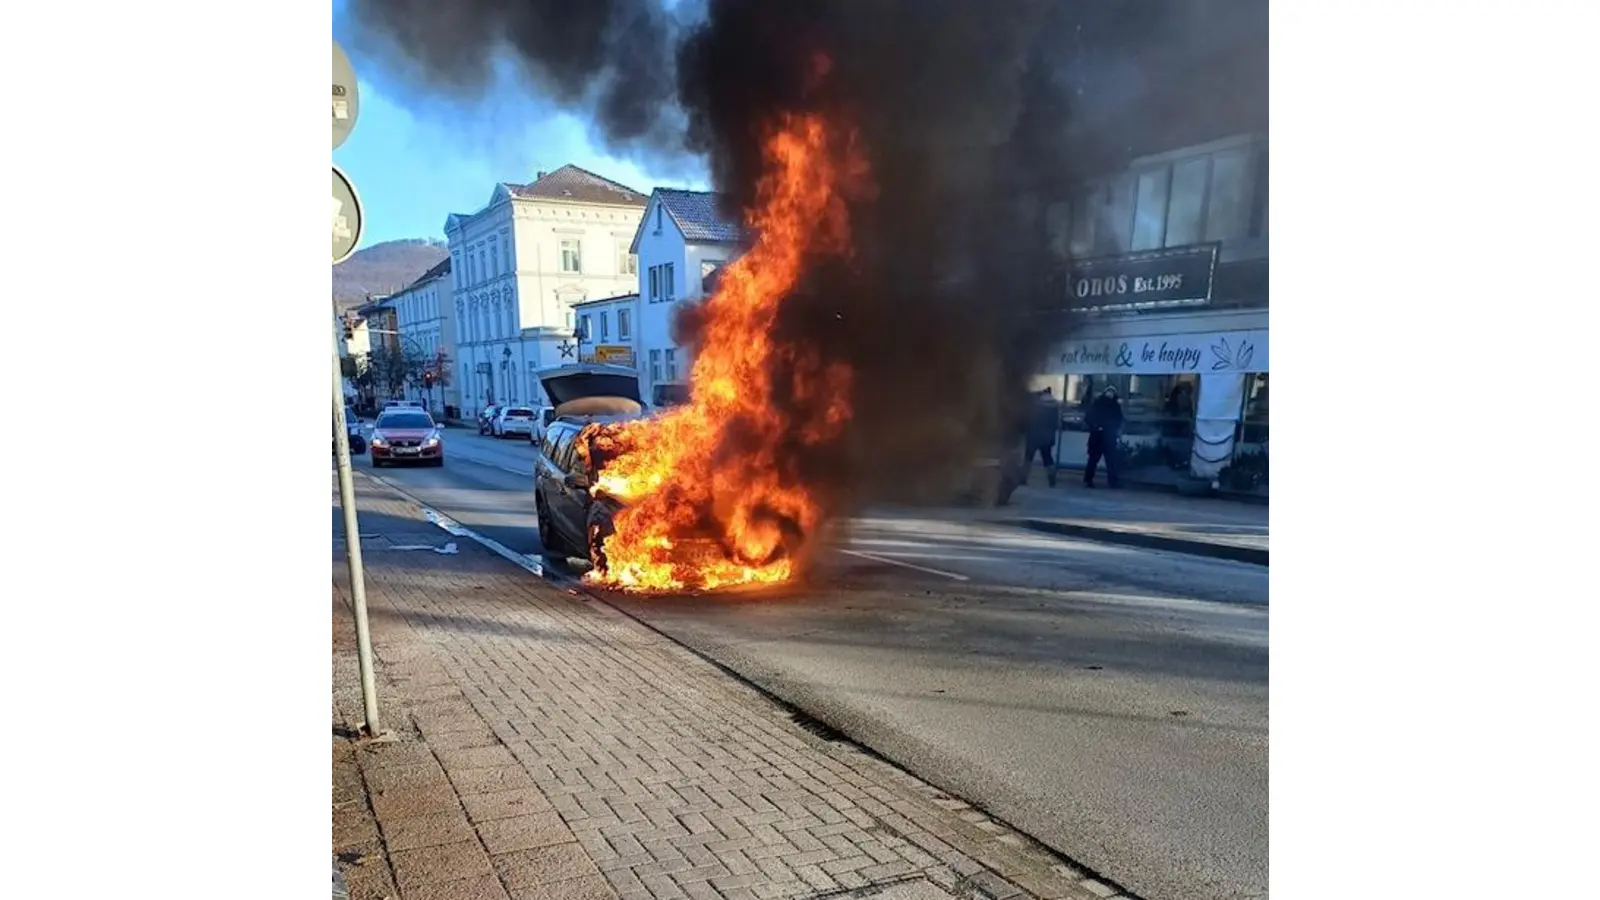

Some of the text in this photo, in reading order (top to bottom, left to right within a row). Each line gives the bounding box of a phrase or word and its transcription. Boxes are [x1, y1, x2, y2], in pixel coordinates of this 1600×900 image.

[1115, 342, 1133, 367] &
[1141, 342, 1155, 362] be
[1158, 341, 1201, 370] happy
